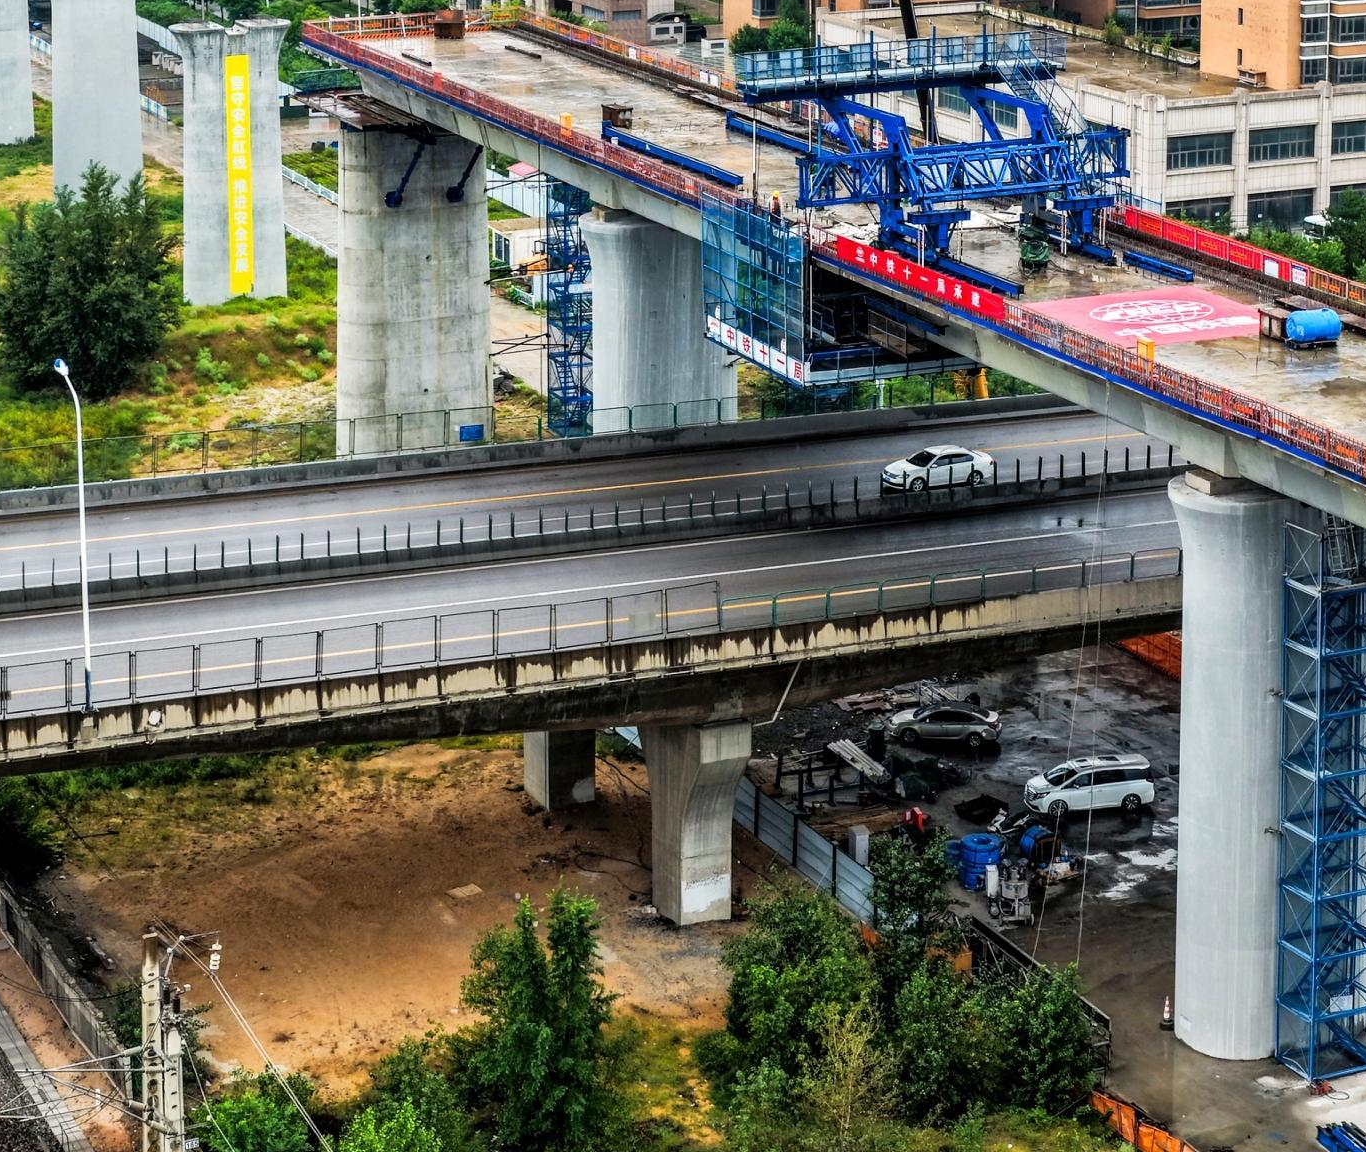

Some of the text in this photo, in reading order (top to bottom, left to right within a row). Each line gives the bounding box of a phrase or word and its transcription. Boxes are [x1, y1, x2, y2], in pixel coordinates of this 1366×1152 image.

[869, 251, 981, 308] 中铁十一局承建
[726, 327, 803, 382] 中铁十一局
